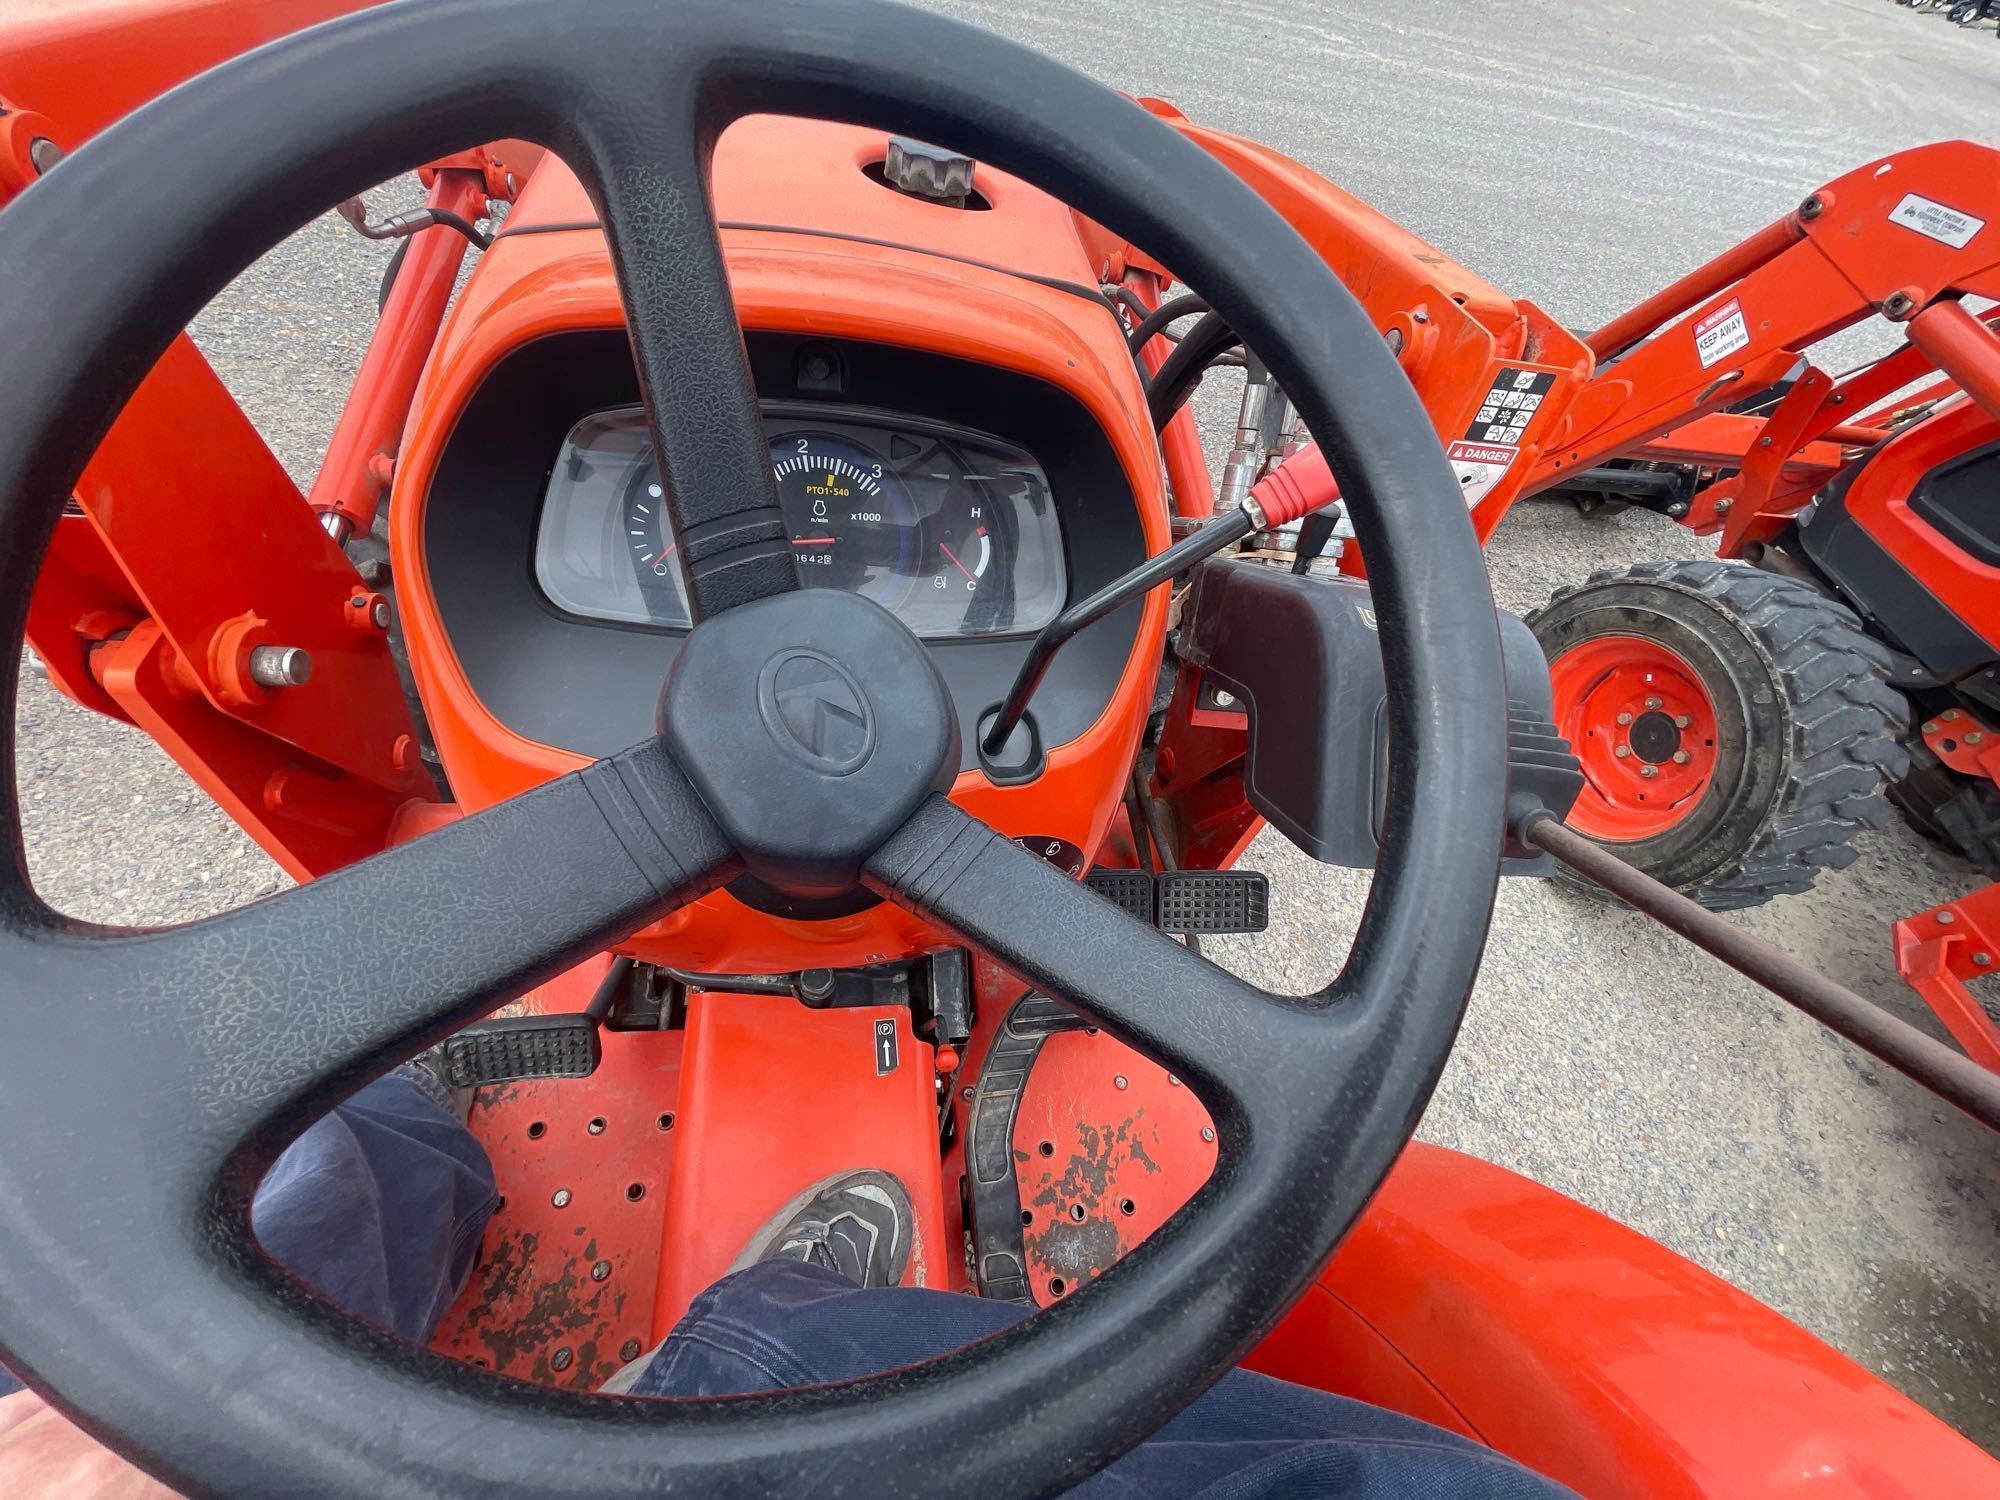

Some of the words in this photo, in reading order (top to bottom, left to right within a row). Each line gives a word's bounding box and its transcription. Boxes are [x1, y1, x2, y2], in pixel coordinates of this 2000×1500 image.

[1705, 302, 1737, 327] WARNING
[1699, 332, 1717, 351] KEEP
[1720, 317, 1741, 339] AWAY
[1703, 353, 1715, 362] from
[1715, 340, 1735, 356] working
[1735, 333, 1746, 344] area
[797, 439, 809, 454] 2
[1464, 448, 1510, 461] DANGER
[871, 464, 882, 478] 3
[850, 512, 881, 522] x1000
[971, 507, 981, 518] H
[967, 580, 976, 591] C
